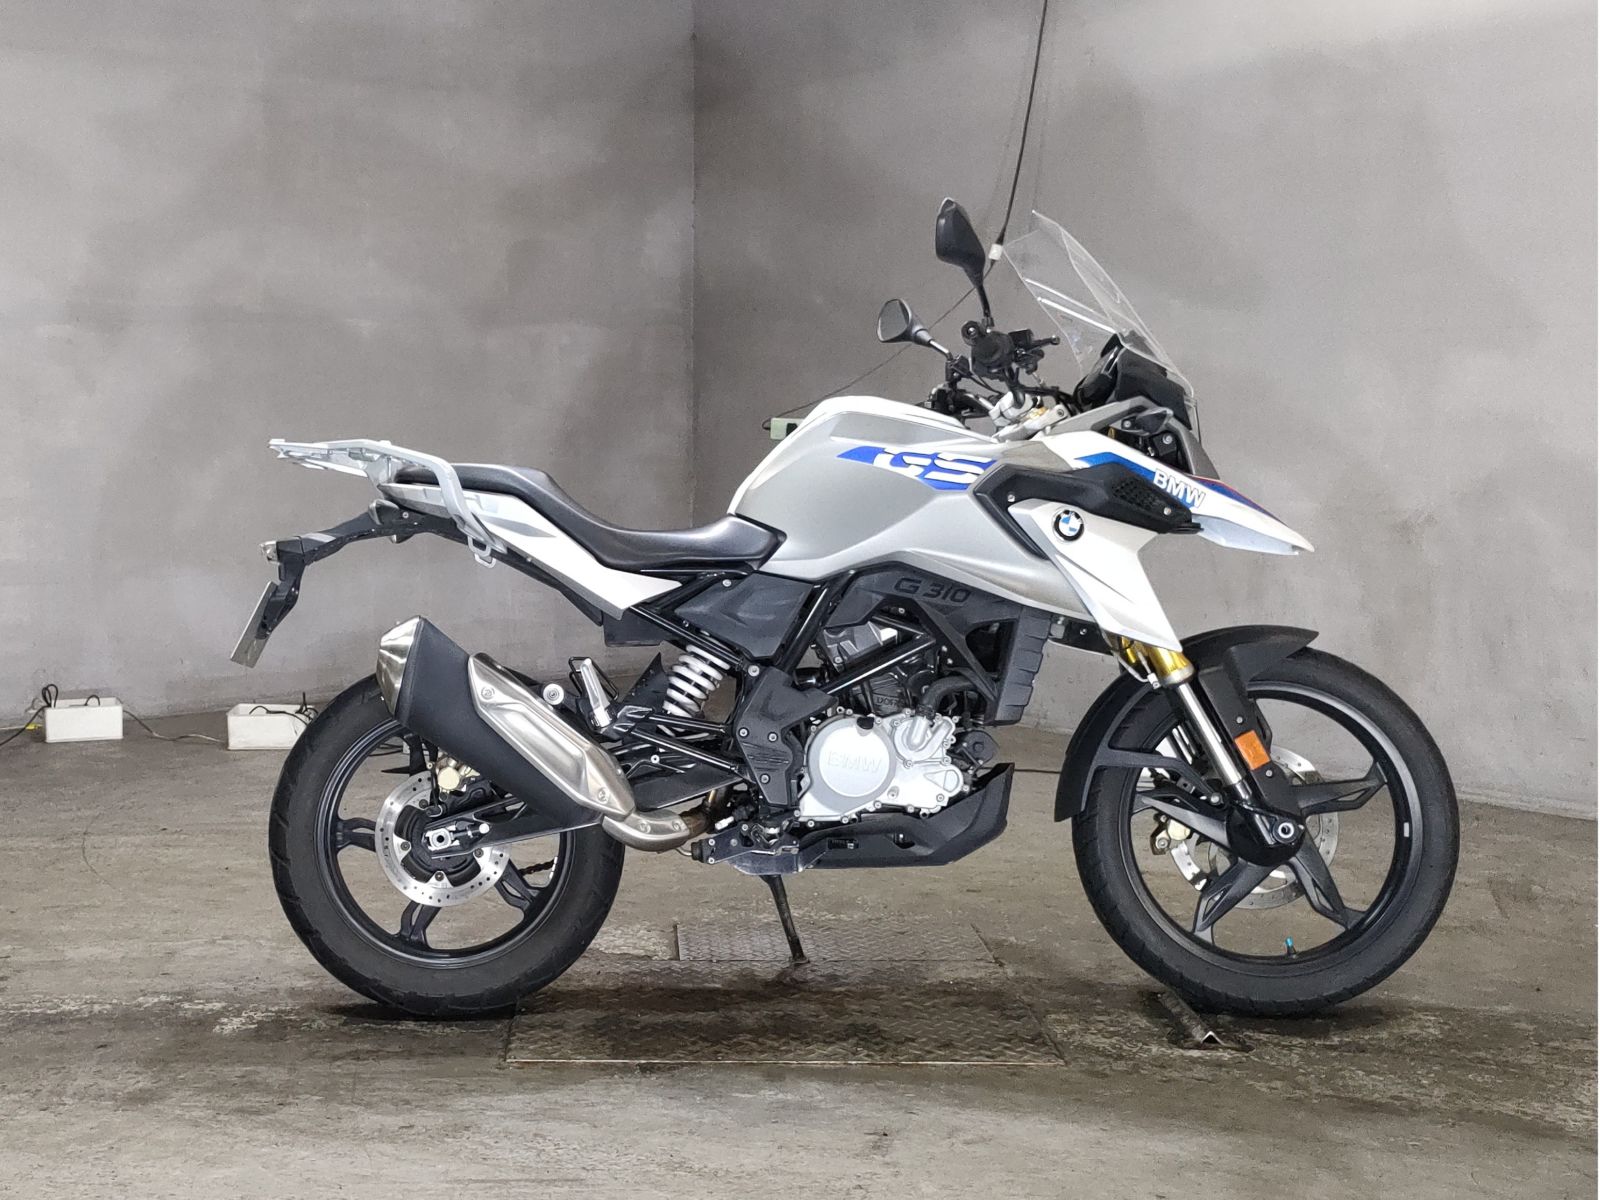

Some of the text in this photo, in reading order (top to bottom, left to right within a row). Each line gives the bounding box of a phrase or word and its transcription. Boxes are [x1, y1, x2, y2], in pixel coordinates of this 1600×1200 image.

[873, 447, 992, 484] GS
[1153, 469, 1206, 508] BMW
[894, 578, 971, 603] G 310
[828, 750, 883, 774] BMW
